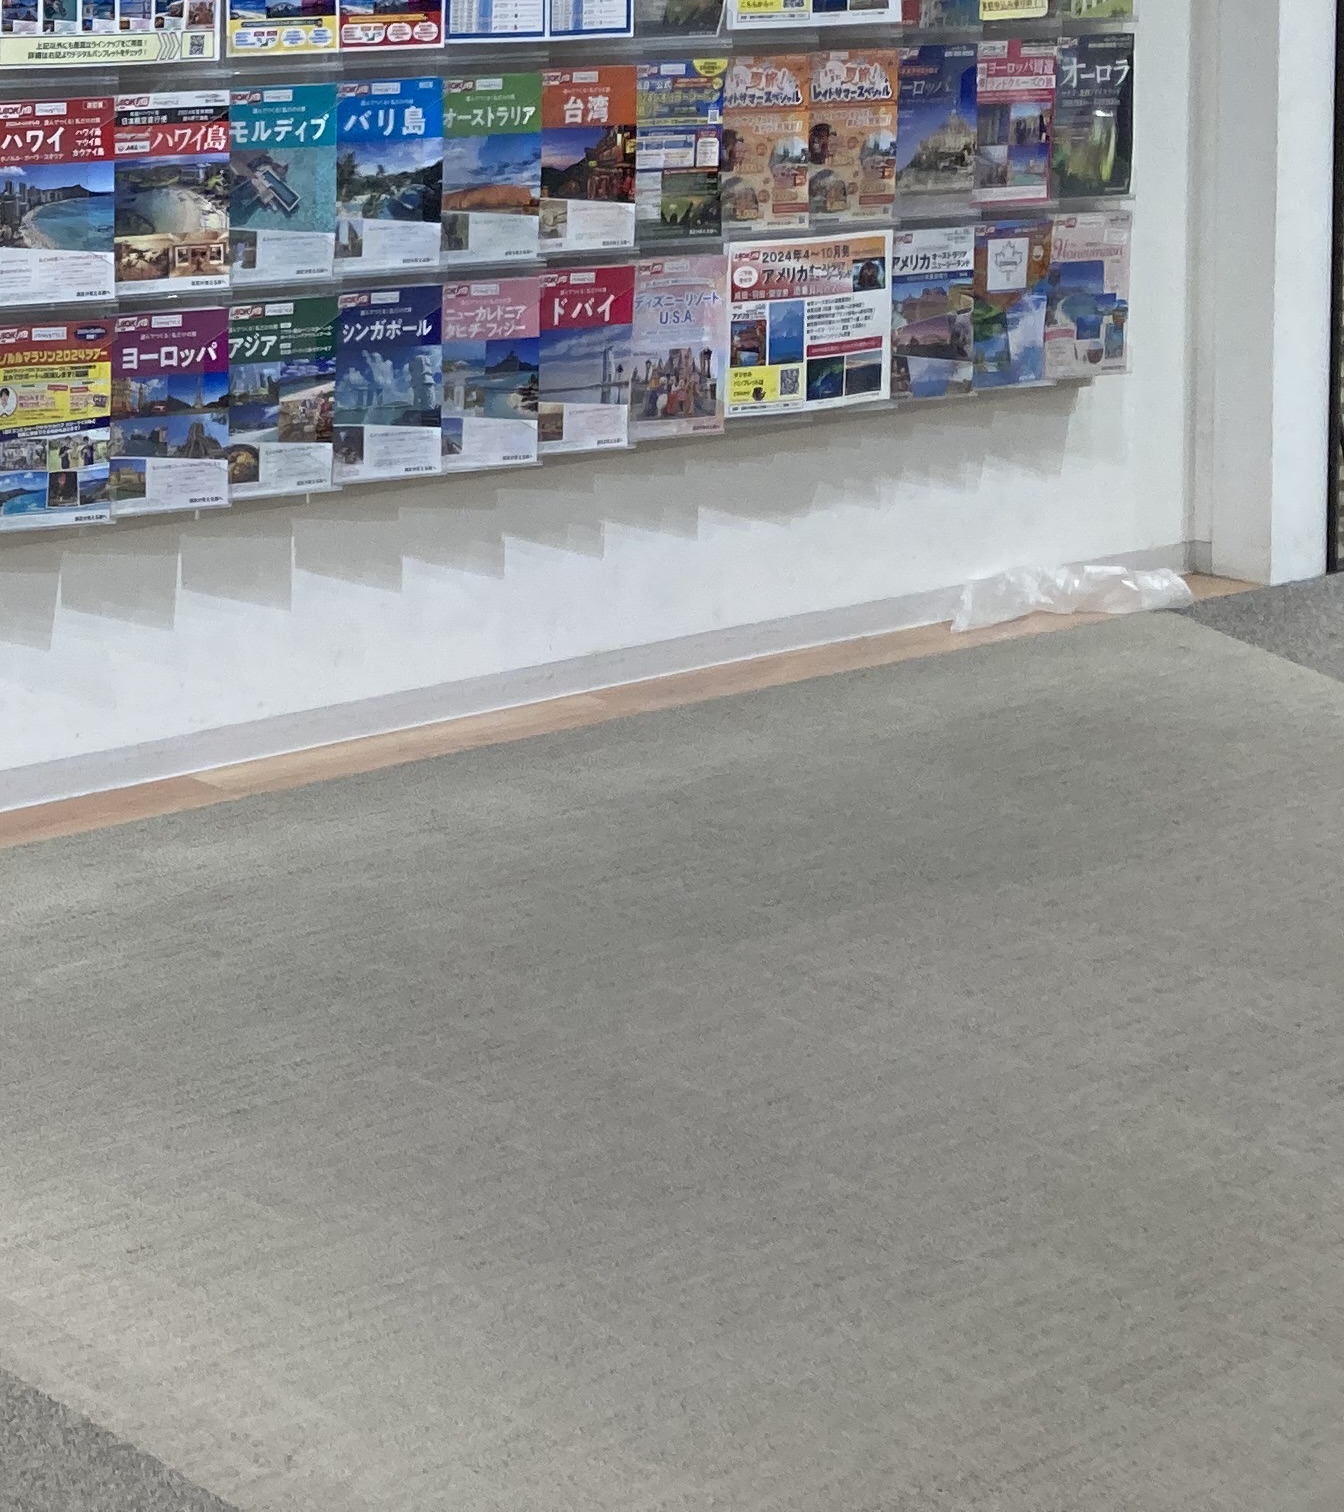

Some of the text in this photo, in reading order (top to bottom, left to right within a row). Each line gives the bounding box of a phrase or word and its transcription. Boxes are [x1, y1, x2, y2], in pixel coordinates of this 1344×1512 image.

[1060, 57, 1131, 87] オーロラ
[344, 107, 426, 136] バリ島
[443, 106, 536, 128] オーストラリア
[564, 95, 609, 124] 台湾
[1, 126, 65, 152] ハワイ
[151, 125, 227, 152] ハワイ島
[231, 113, 329, 144] モルディブ
[763, 266, 807, 284] アメリカ
[553, 295, 615, 326] ドバイ
[635, 292, 721, 310] ディズニーリゾート
[342, 319, 432, 343] シンガポール
[122, 342, 217, 370] ヨーロッパ
[229, 335, 278, 358] アジア
